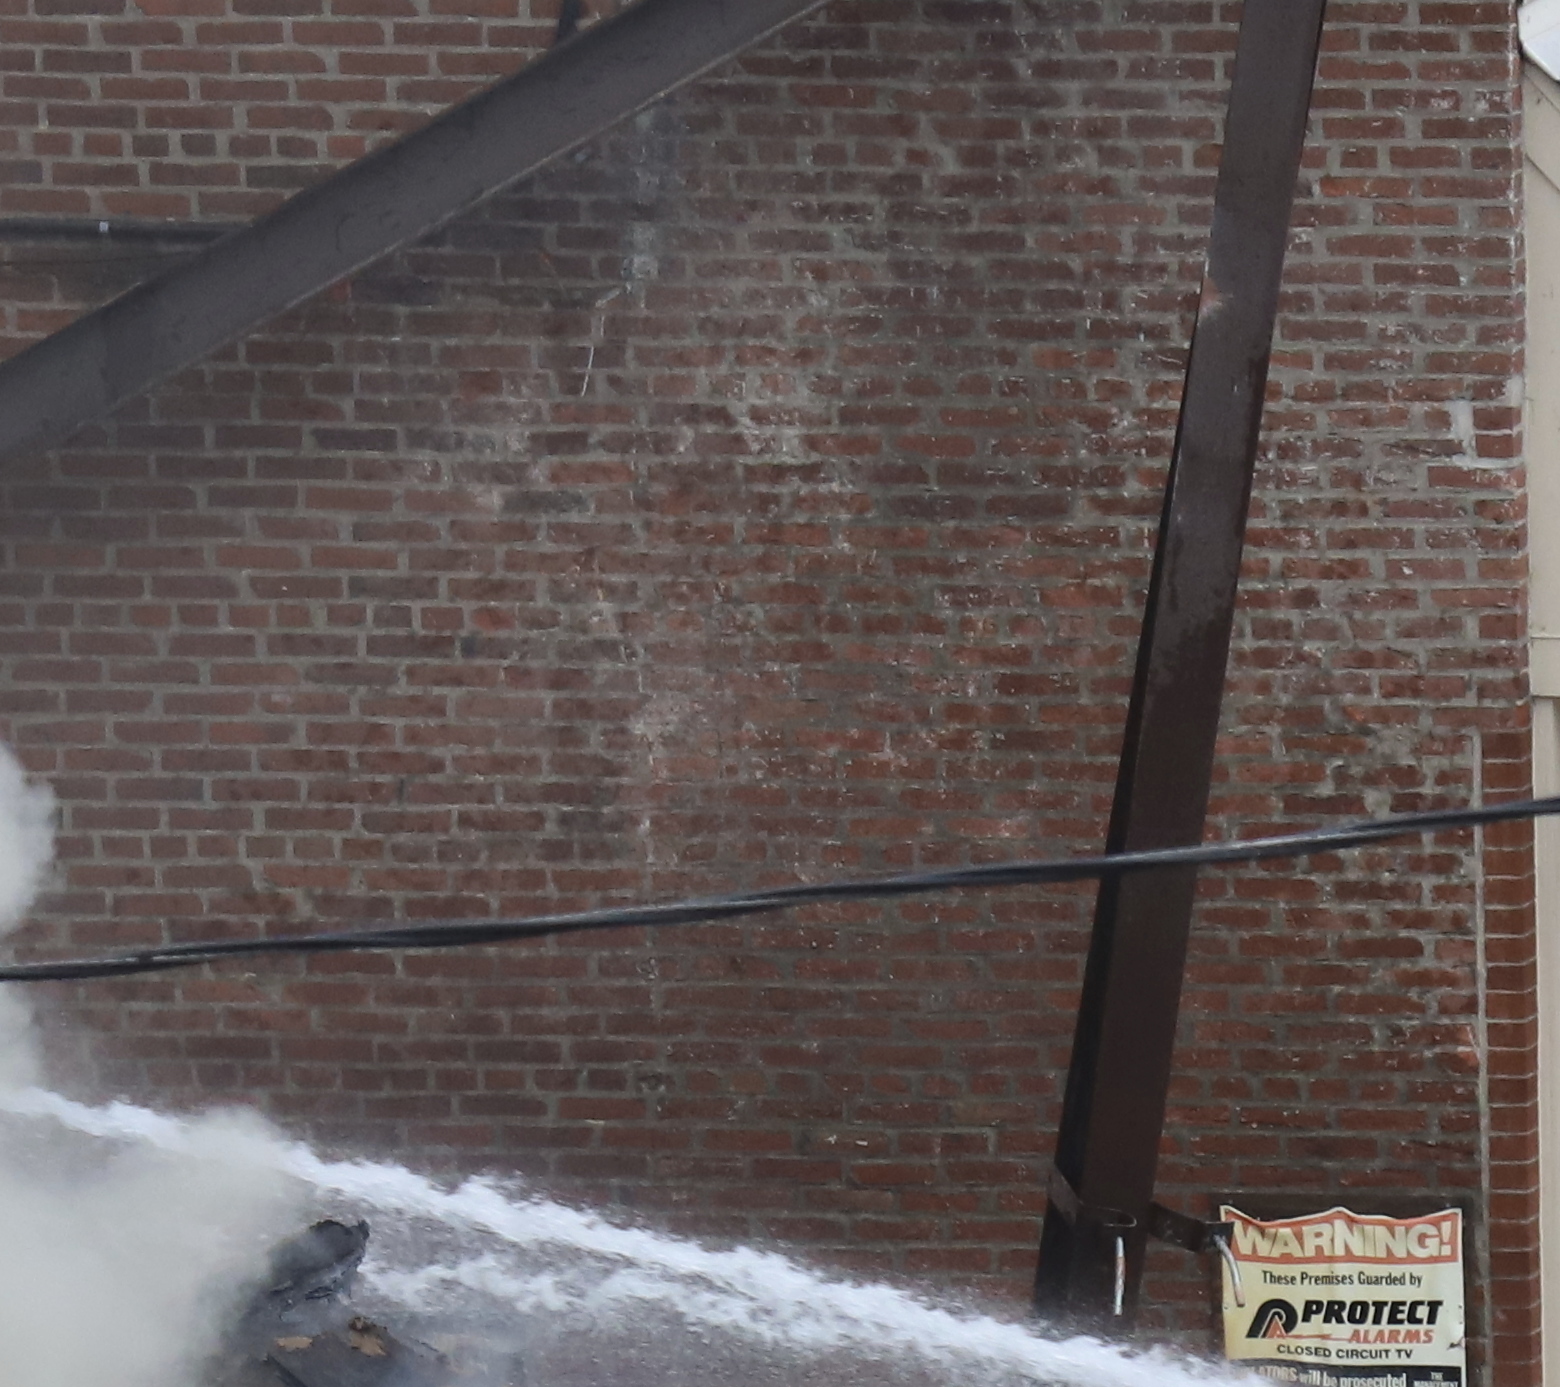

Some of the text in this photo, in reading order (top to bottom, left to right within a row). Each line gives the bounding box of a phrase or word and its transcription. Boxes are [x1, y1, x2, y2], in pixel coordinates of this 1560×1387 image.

[1233, 1219, 1452, 1258] WARNING!
[1261, 1270, 1423, 1288] These Premises Guarded by
[1301, 1299, 1444, 1325] PROTECT
[1348, 1329, 1435, 1344] ALARMS
[1277, 1344, 1413, 1359] CLOSED CIRCUIT TV
[1299, 1370, 1321, 1386] will
[1323, 1371, 1339, 1387] be
[1430, 1371, 1444, 1381] THE
